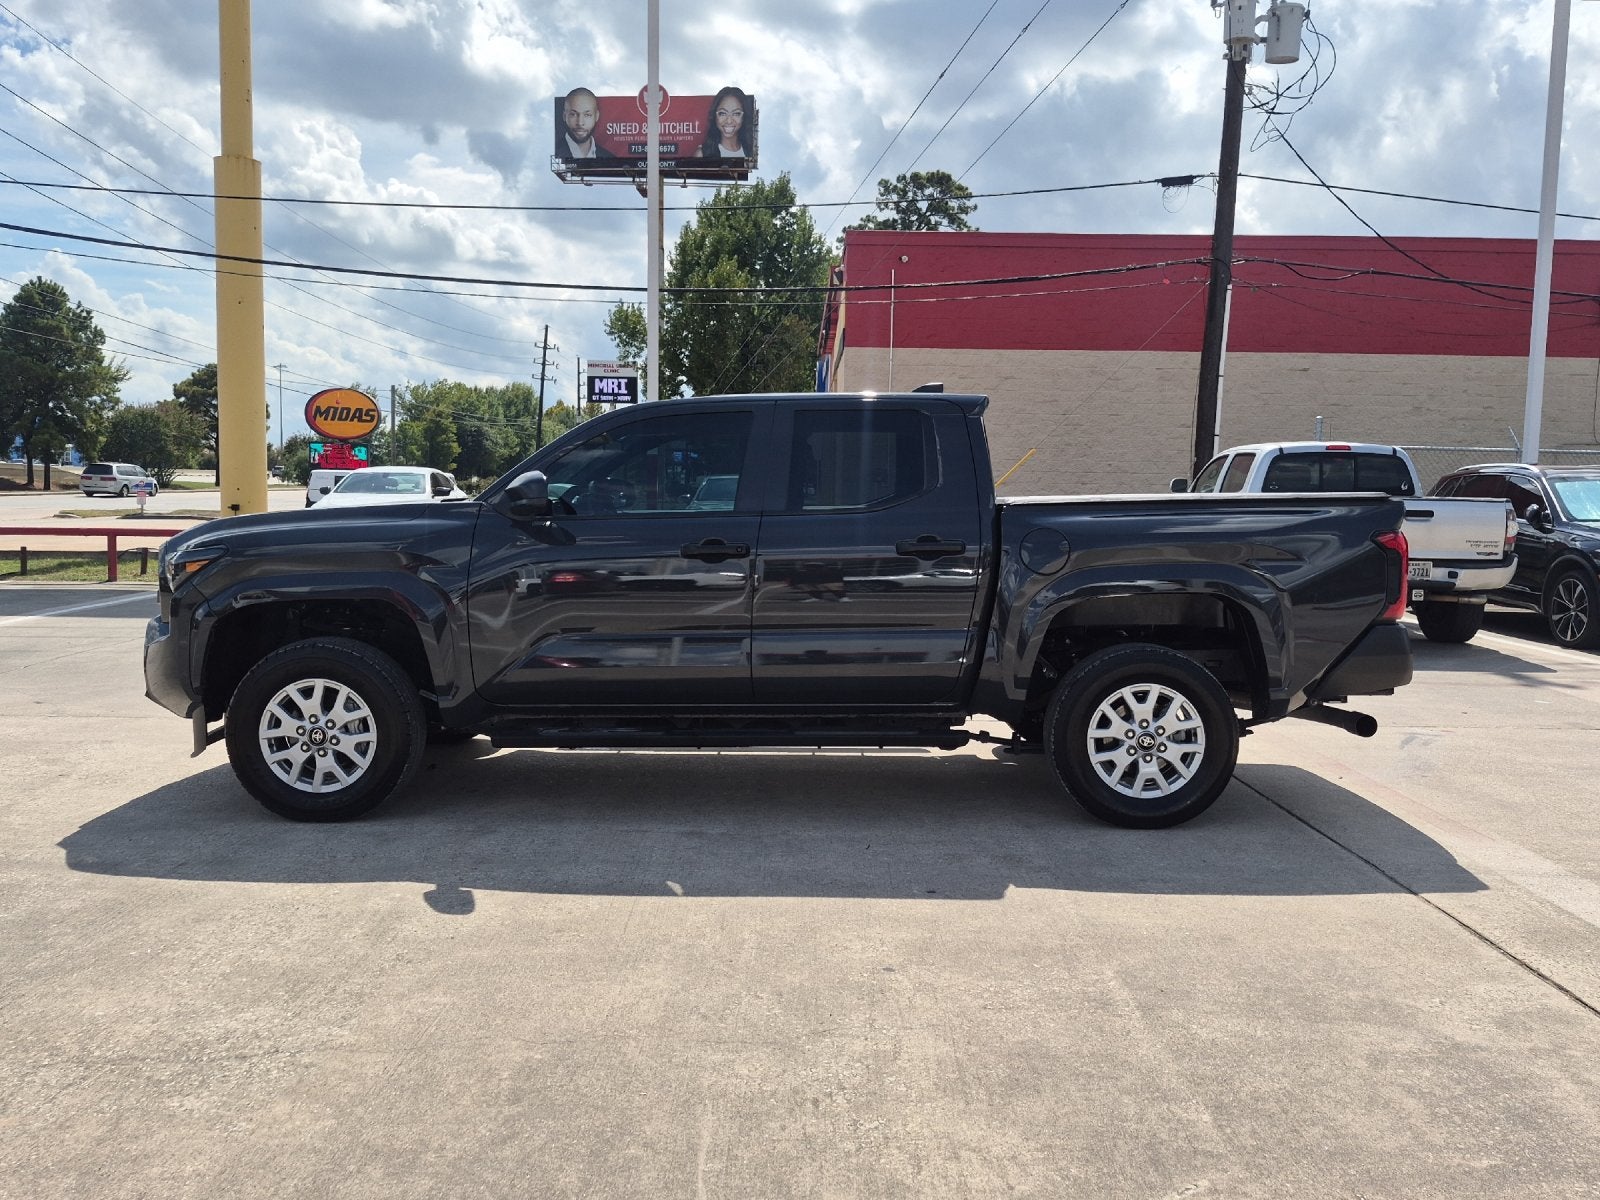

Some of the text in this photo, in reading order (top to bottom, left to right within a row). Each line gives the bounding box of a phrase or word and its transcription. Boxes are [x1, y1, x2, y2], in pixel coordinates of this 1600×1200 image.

[606, 122, 640, 135] SNEED
[594, 378, 628, 394] MRI
[313, 406, 376, 423] MIDAS
